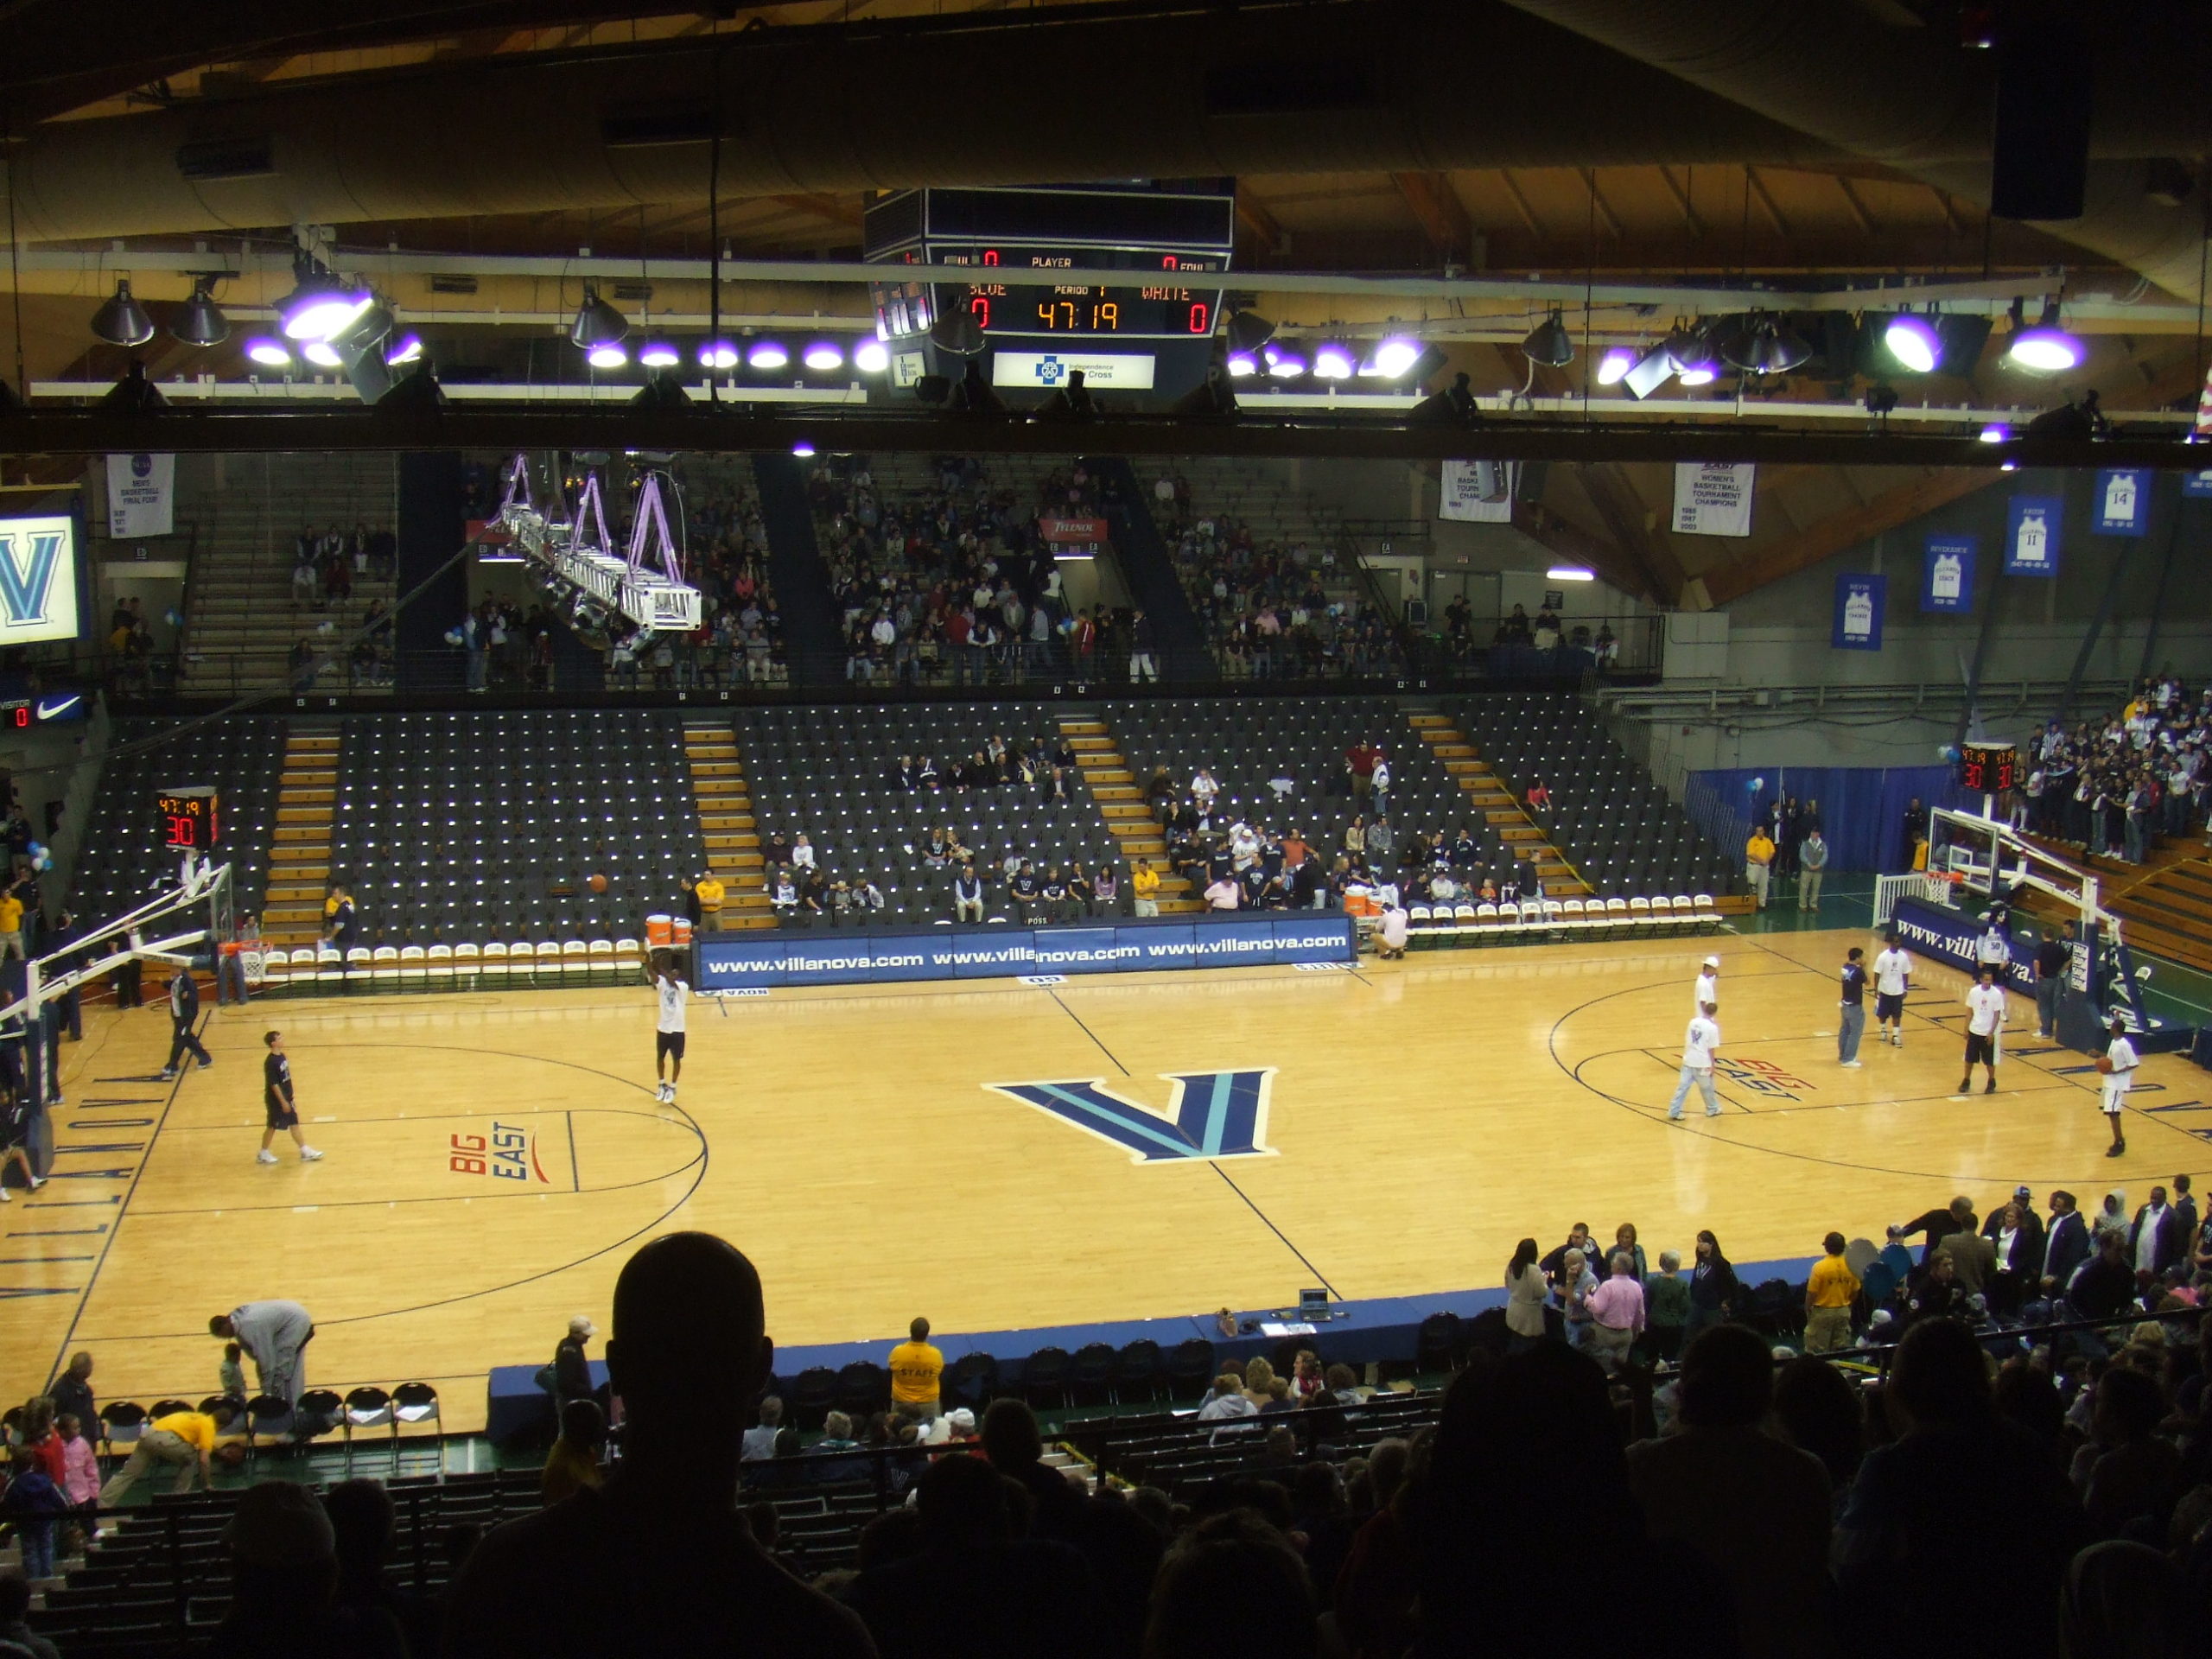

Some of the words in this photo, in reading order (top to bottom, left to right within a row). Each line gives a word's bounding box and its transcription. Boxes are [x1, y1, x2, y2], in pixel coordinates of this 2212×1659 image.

[1032, 257, 1071, 268] PLAYER
[1055, 286, 1089, 295] PERIOD
[1141, 287, 1191, 302] WHITE
[1039, 302, 1118, 330] 47:19
[1190, 304, 1207, 333] 0
[1088, 370, 1113, 379] Cross
[1693, 490, 1741, 499] TOURNAMENT
[2113, 493, 2128, 505] 14
[1055, 522, 1094, 532] TYLENOL
[2026, 534, 2037, 546] 11
[16, 708, 28, 728] 0
[159, 798, 200, 816] 47:19
[166, 816, 194, 845] 30
[1148, 935, 1347, 957] www.villanova.com
[709, 955, 924, 974] www.villanova.com
[932, 947, 1141, 965] www.villanova.com
[1733, 1058, 1817, 1090] BIG
[980, 1066, 1281, 1166] V
[449, 1133, 486, 1175] BIG
[493, 1122, 527, 1180] EAST
